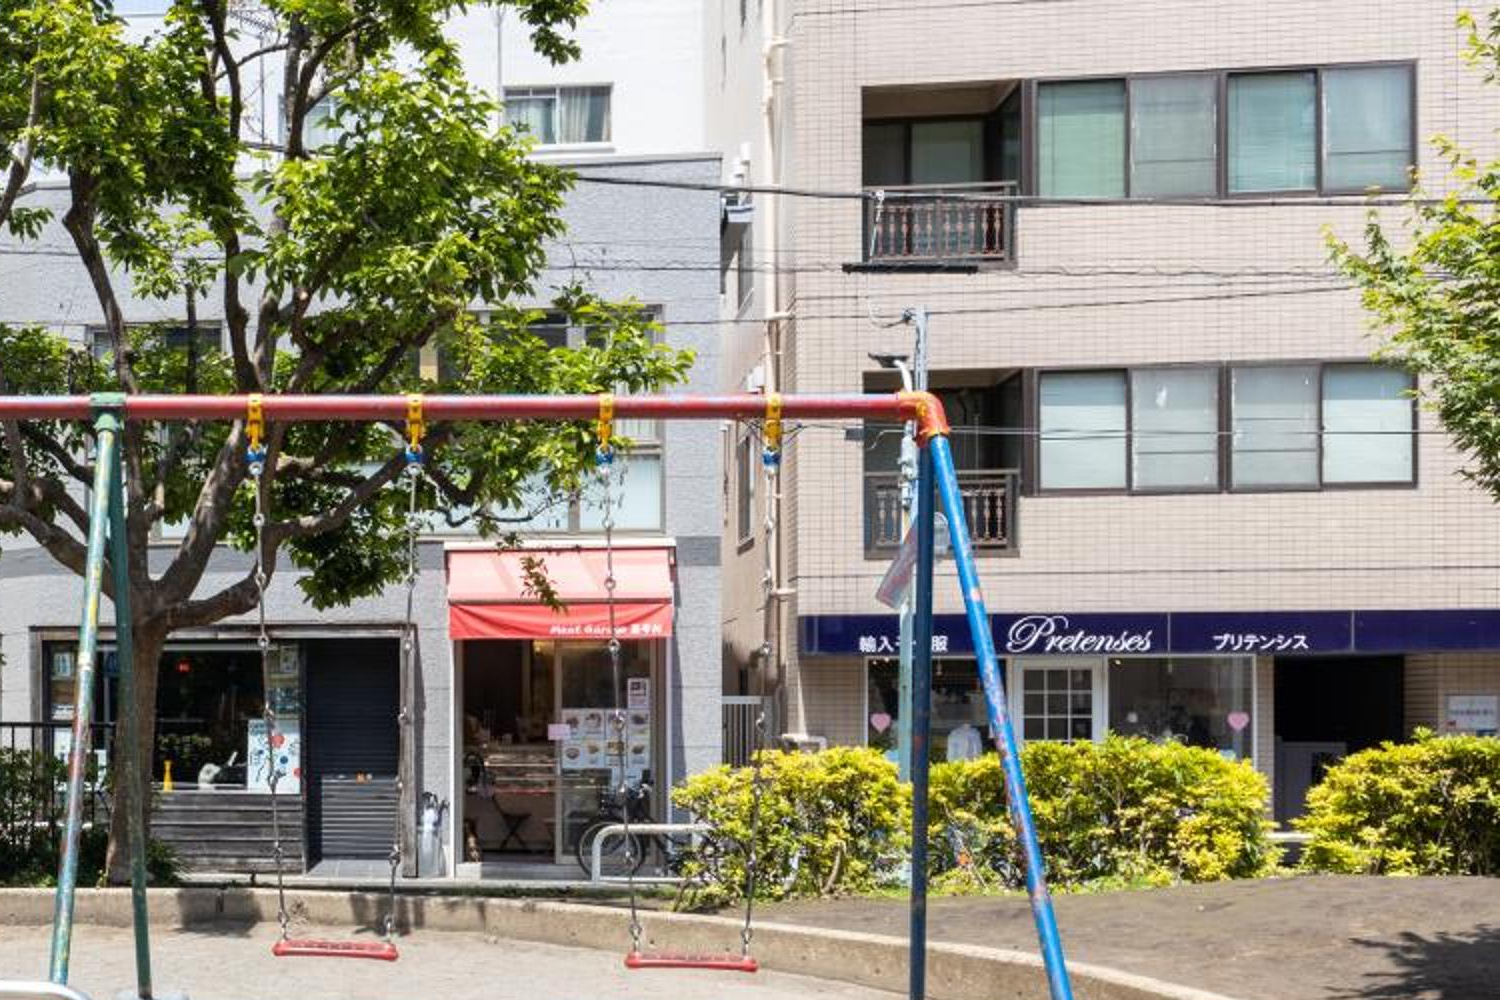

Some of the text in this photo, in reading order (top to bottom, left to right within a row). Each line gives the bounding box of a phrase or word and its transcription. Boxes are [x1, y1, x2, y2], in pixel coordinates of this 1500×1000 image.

[1006, 615, 1153, 652] Pretenses
[1213, 634, 1309, 650] プリテンシス
[859, 635, 948, 652] 輸入服
